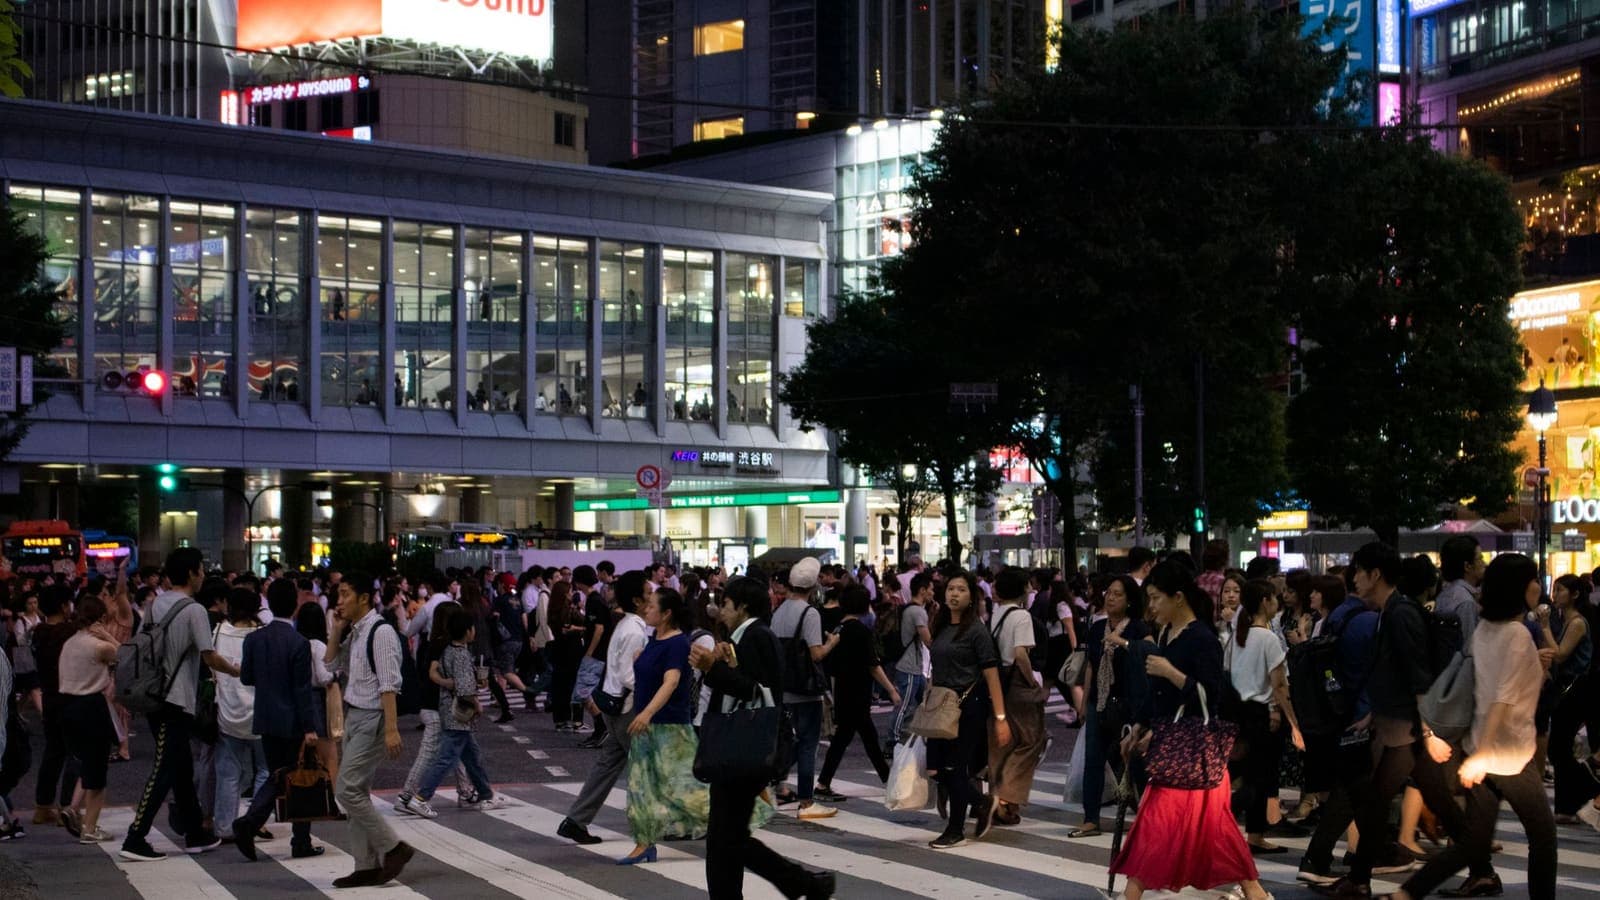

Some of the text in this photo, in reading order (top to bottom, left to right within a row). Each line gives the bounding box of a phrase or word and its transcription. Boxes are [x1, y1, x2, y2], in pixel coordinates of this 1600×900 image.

[251, 83, 296, 102] カラオケ
[297, 77, 352, 97] JOYSOUND
[672, 450, 699, 462] KEIO
[738, 451, 773, 466] 渋谷駅
[713, 495, 735, 505] CITY
[1554, 495, 1600, 523] L'OC
